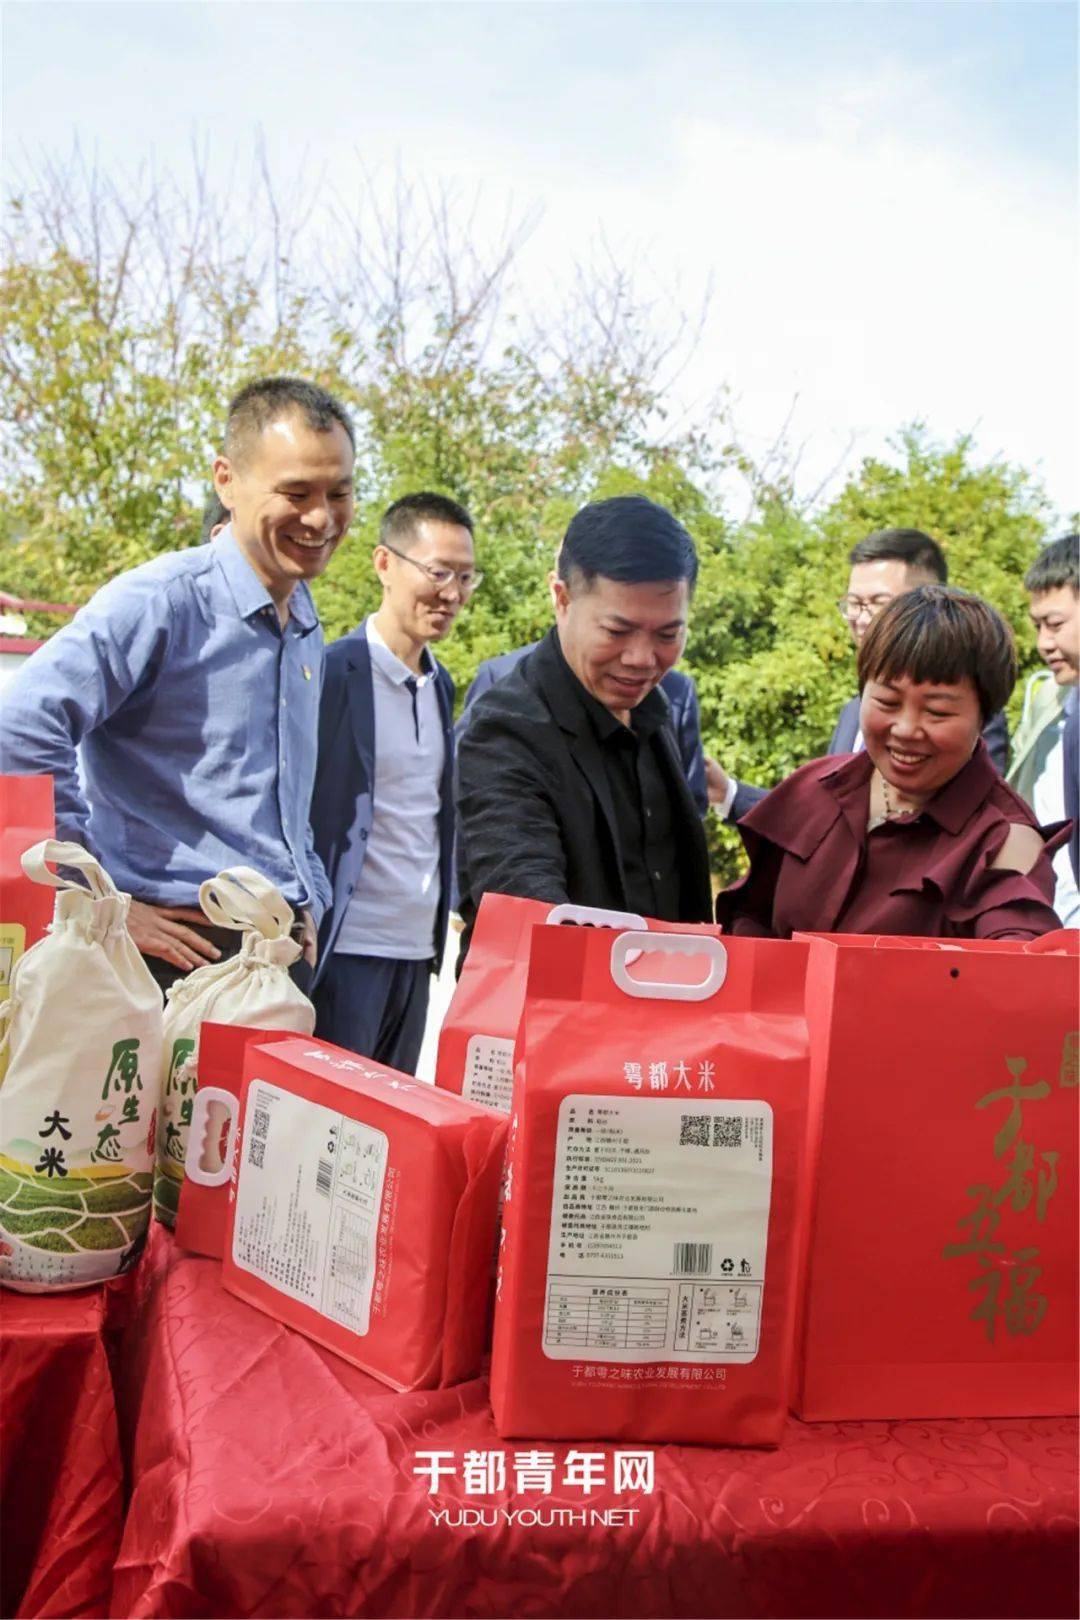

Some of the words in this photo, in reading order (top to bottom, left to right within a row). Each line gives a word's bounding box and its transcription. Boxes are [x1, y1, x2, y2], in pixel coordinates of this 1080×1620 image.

[90, 1038, 143, 1163] 原生态
[623, 1061, 716, 1092] 雩都大米
[35, 1110, 72, 1178] 大米
